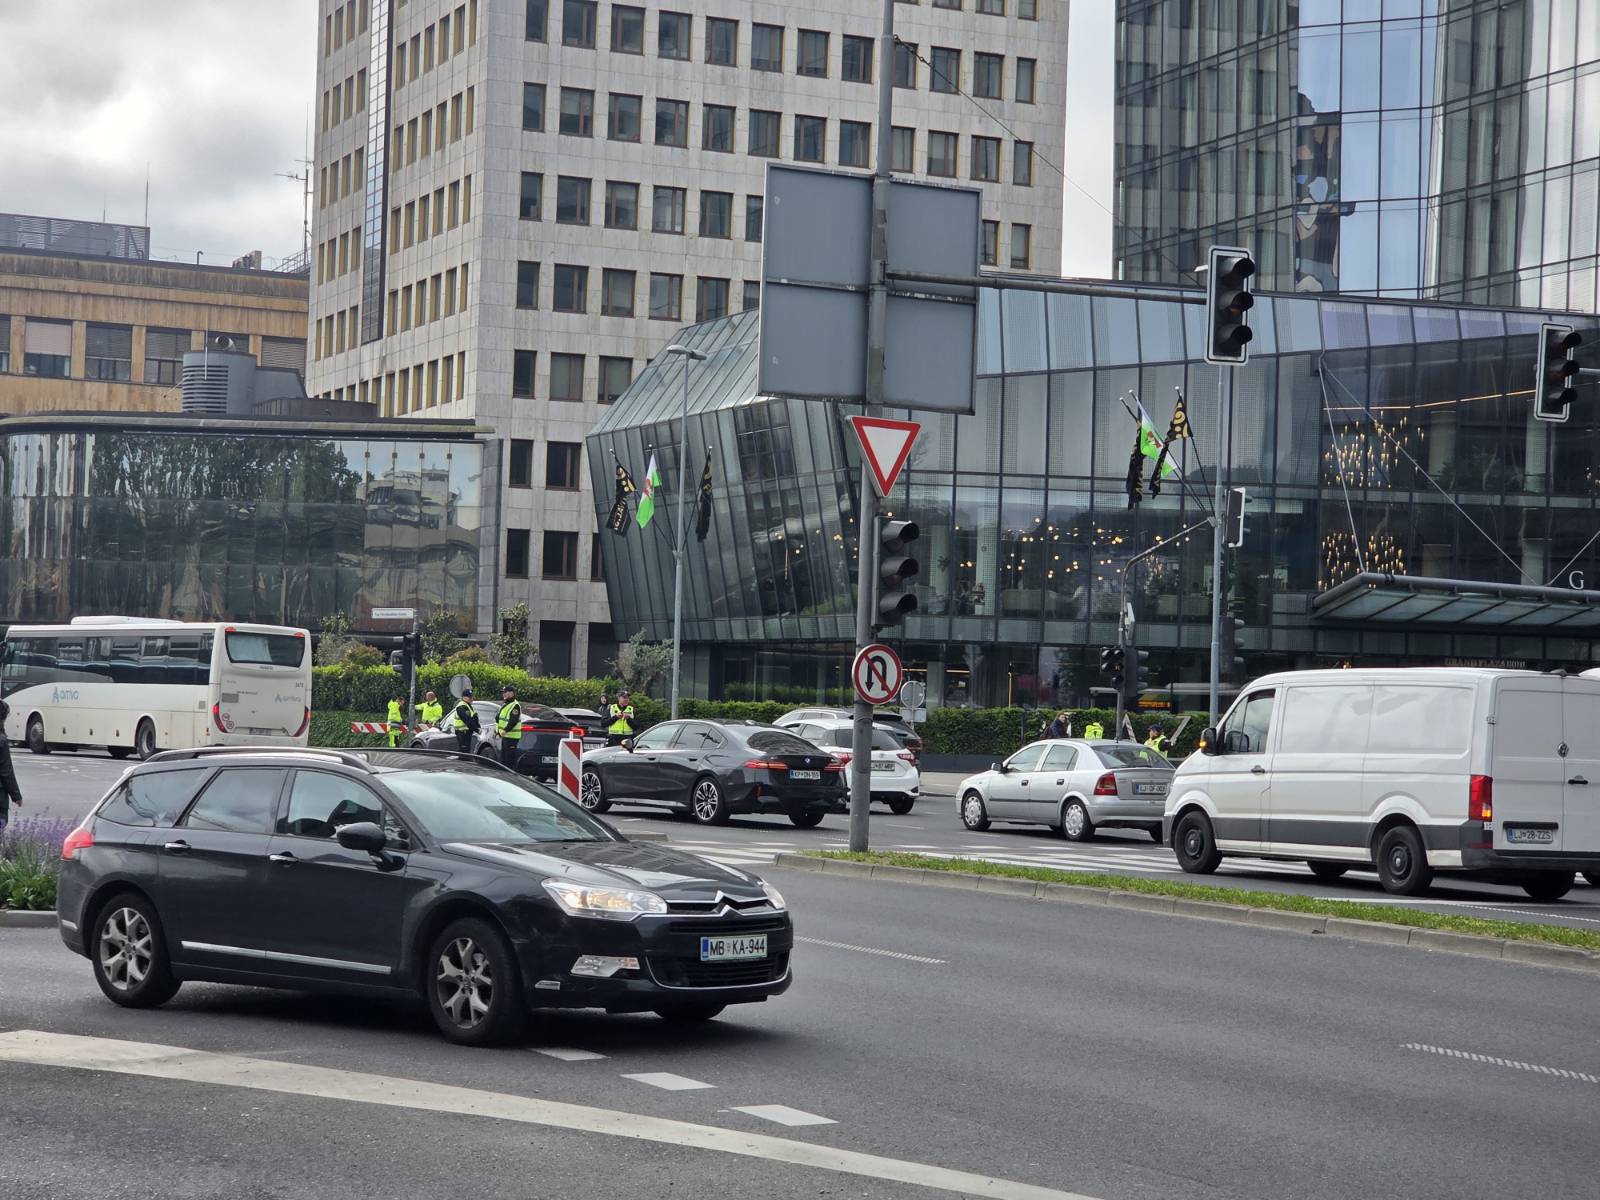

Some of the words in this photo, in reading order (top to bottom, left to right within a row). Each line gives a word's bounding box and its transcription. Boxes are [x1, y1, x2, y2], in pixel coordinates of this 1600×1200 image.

[1569, 570, 1584, 590] G
[1513, 830, 1522, 840] LJ
[709, 940, 725, 956] MB
[732, 938, 765, 954] KA-944
